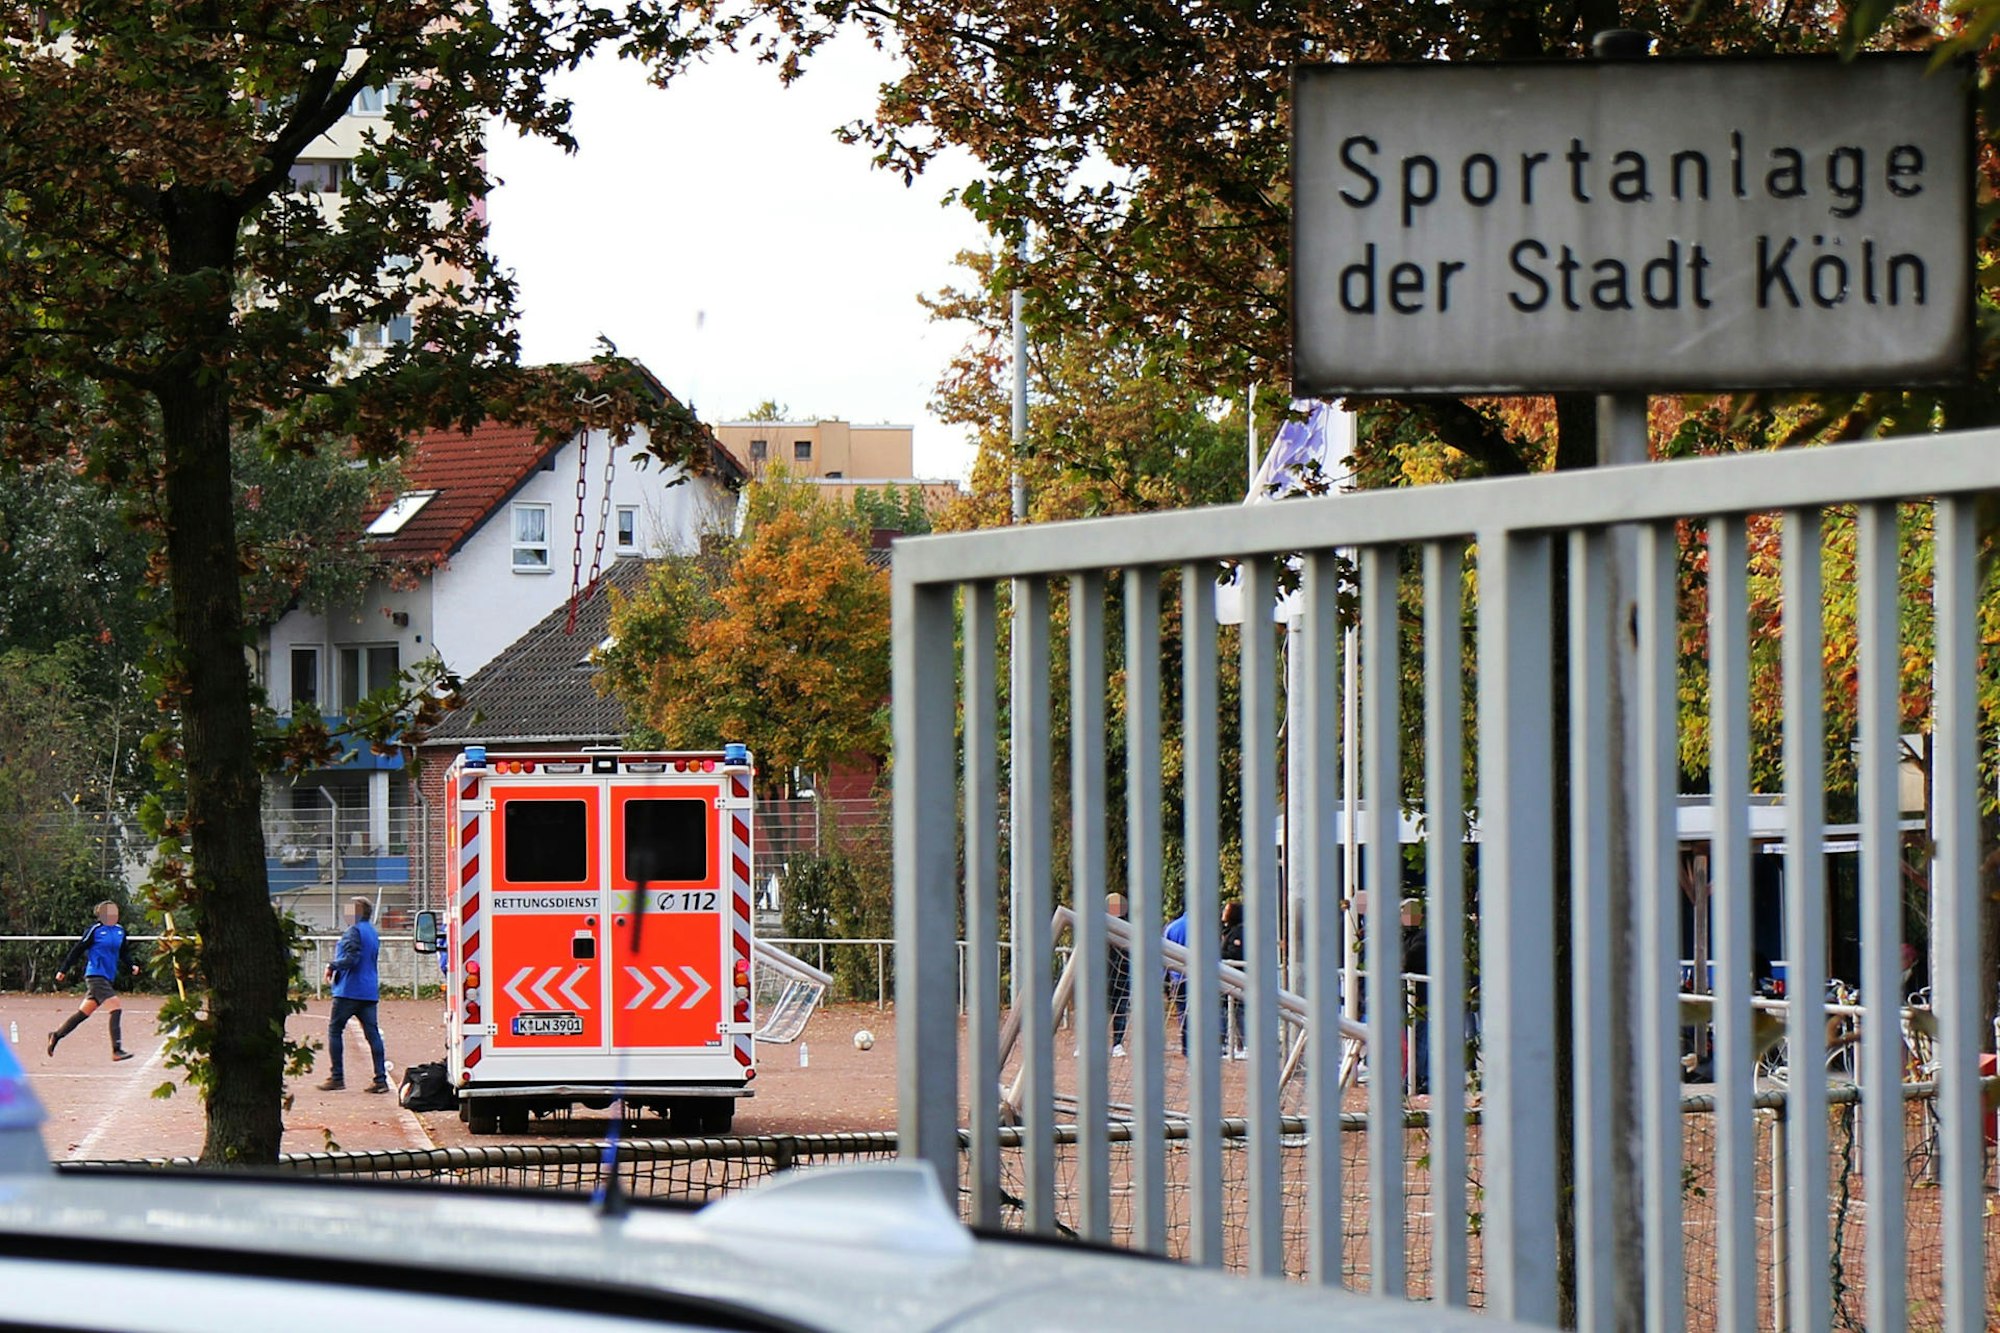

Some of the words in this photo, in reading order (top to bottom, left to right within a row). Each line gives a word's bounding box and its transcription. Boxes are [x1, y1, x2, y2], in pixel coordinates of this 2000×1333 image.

[1338, 129, 1925, 227] Sportanlage
[1338, 242, 1466, 315] der
[1506, 236, 1714, 313] Stadt
[1755, 234, 1928, 309] Köln
[494, 897, 598, 909] RETTUNGSDIENST
[681, 892, 717, 911] 112
[519, 1019, 527, 1031] K
[535, 1019, 551, 1031] LN
[552, 1019, 581, 1031] 3901
